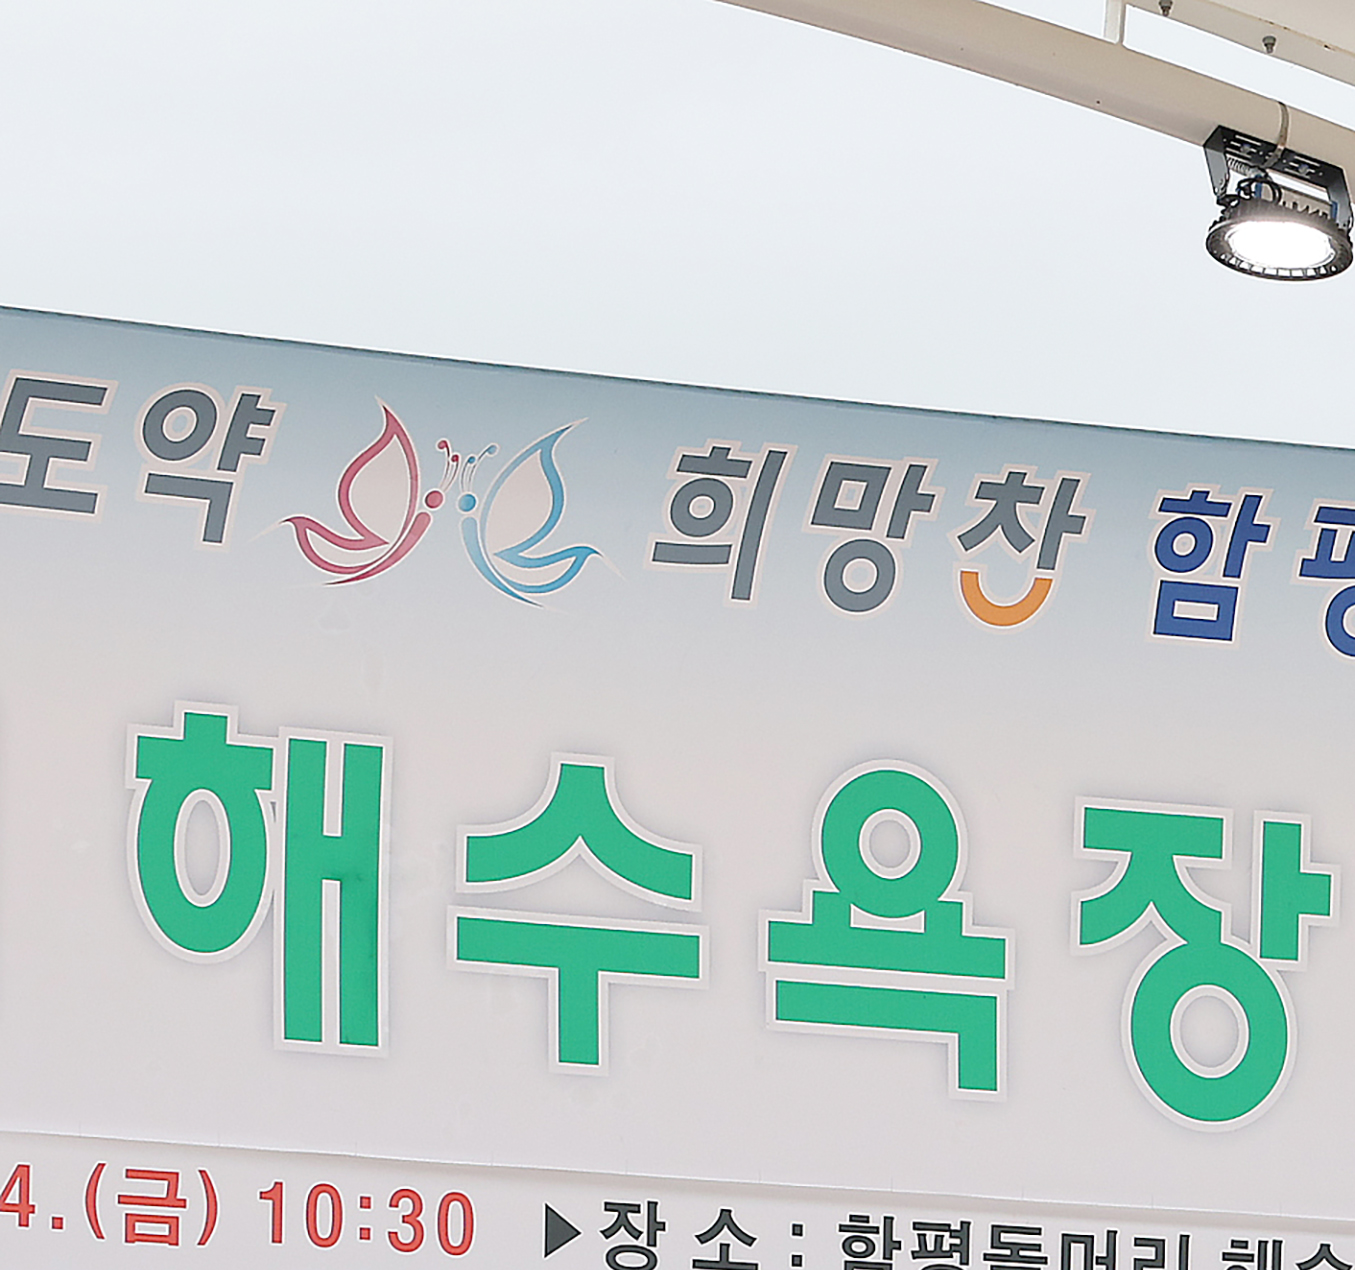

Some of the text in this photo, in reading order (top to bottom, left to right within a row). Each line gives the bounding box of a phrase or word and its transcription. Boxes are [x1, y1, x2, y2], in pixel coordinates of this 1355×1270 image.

[0, 376, 277, 546] 도약
[136, 711, 1332, 1122] 해수욕장
[259, 1181, 475, 1256] 10:30
